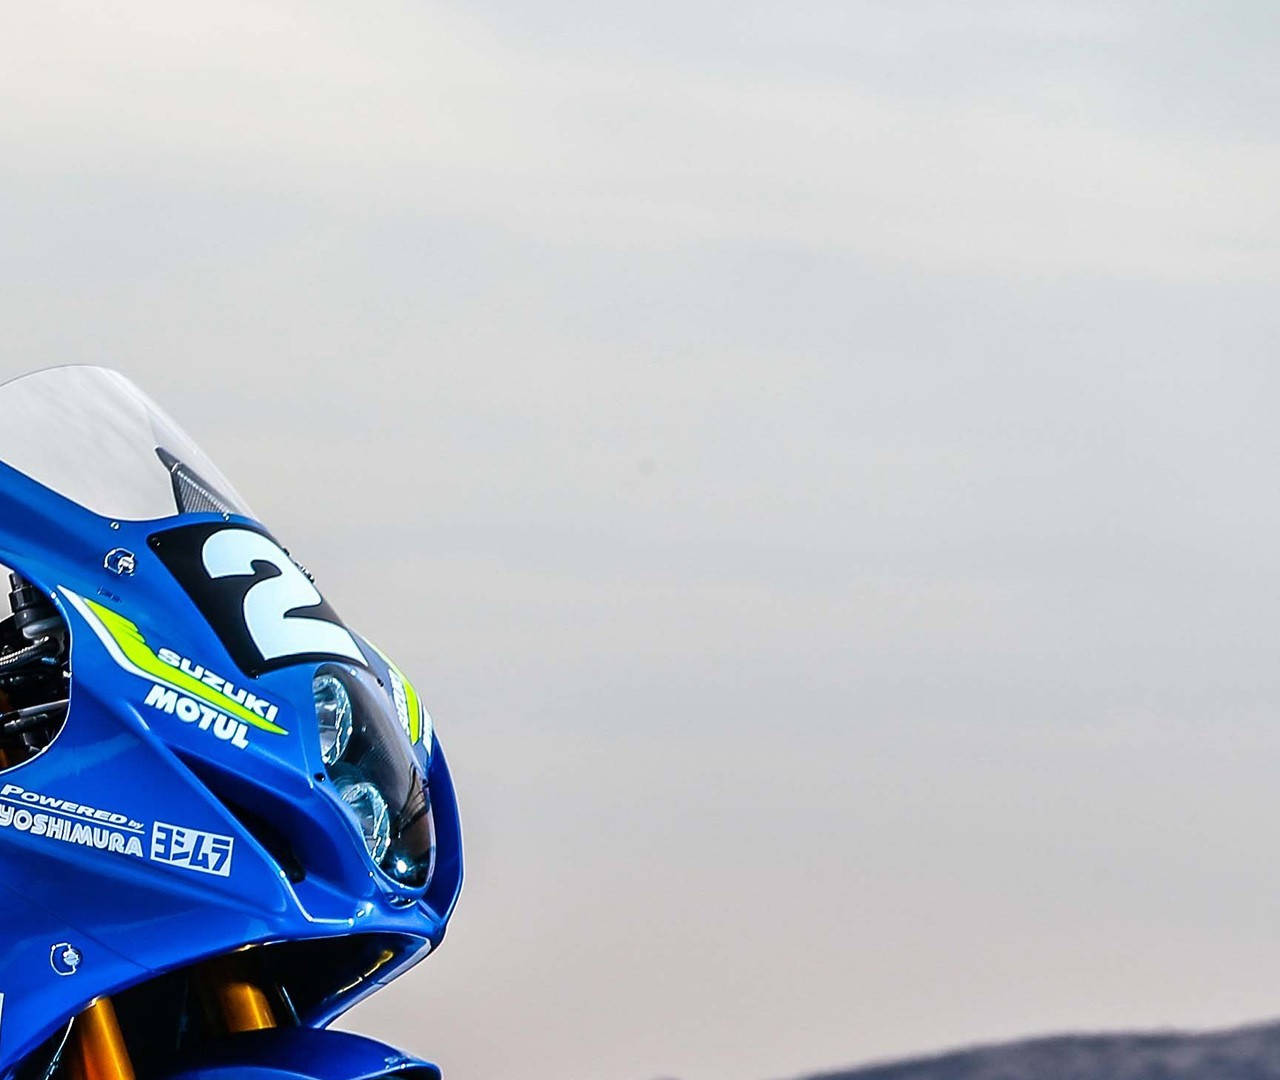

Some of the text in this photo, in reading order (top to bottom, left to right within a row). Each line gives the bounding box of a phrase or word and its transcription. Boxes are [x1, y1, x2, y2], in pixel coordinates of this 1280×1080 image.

[202, 528, 369, 668] 2
[144, 683, 250, 749] MOTUL
[157, 648, 279, 723] SUZUKI
[0, 784, 128, 823] POWERED
